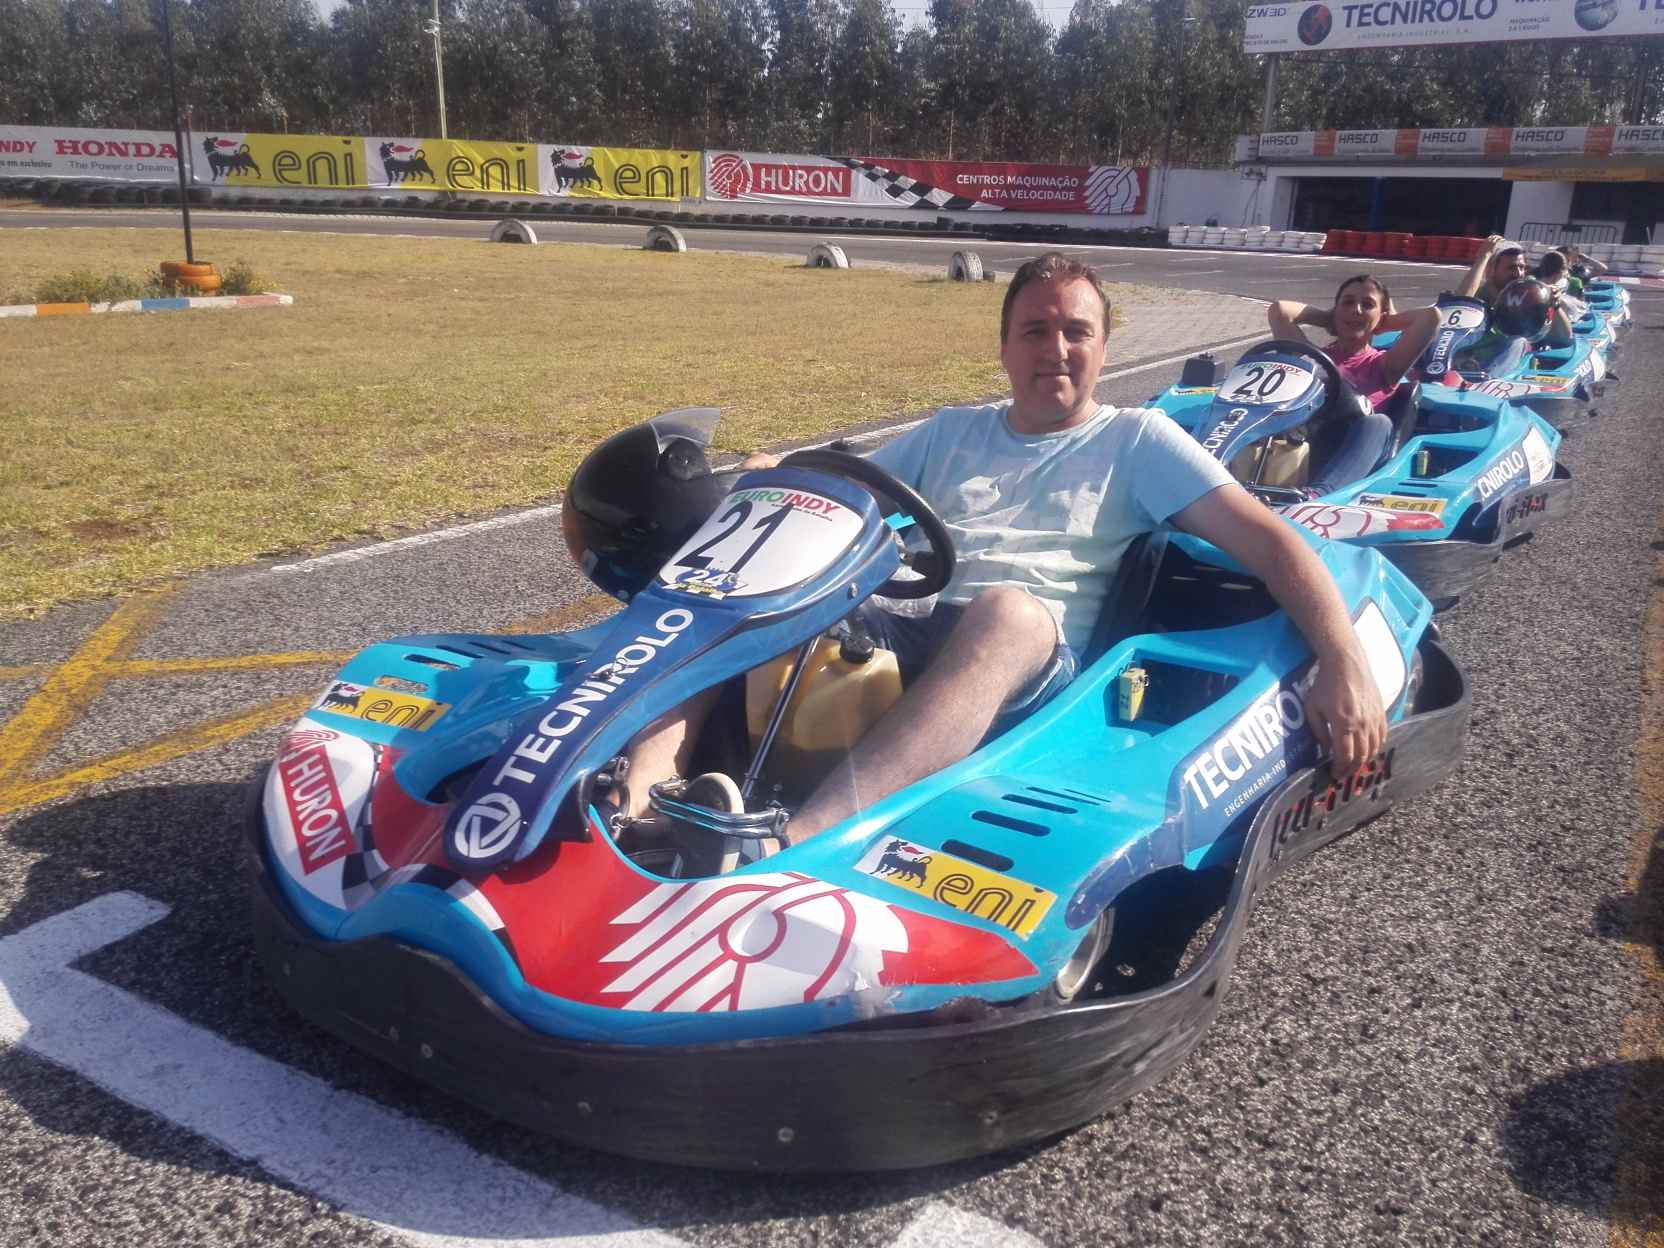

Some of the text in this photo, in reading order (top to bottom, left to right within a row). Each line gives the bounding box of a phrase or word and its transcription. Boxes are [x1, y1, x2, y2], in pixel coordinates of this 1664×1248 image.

[1342, 0, 1498, 28] TECNIROLO
[54, 139, 177, 158] HONDA
[1262, 135, 1299, 146] HASCO
[1338, 133, 1379, 144] HASCO
[1423, 131, 1467, 143] HASCO
[1515, 130, 1565, 142] HASCO
[272, 140, 356, 186] eni
[446, 146, 527, 192] eni
[614, 154, 689, 197] eni
[760, 167, 843, 193] HURON
[956, 174, 1079, 189] CENTROS MAQUINAÇÃO
[980, 189, 1075, 200] ALTA VELOCIDADE
[1447, 310, 1462, 325] 6
[1232, 366, 1286, 397] 20
[1477, 450, 1524, 498] CNIROLO
[727, 490, 841, 515] EUROINDY
[673, 499, 795, 574] 21
[493, 607, 696, 787] TECNIROLO
[361, 698, 443, 730] eni
[287, 751, 347, 864] HURON
[932, 872, 1045, 932] eni
